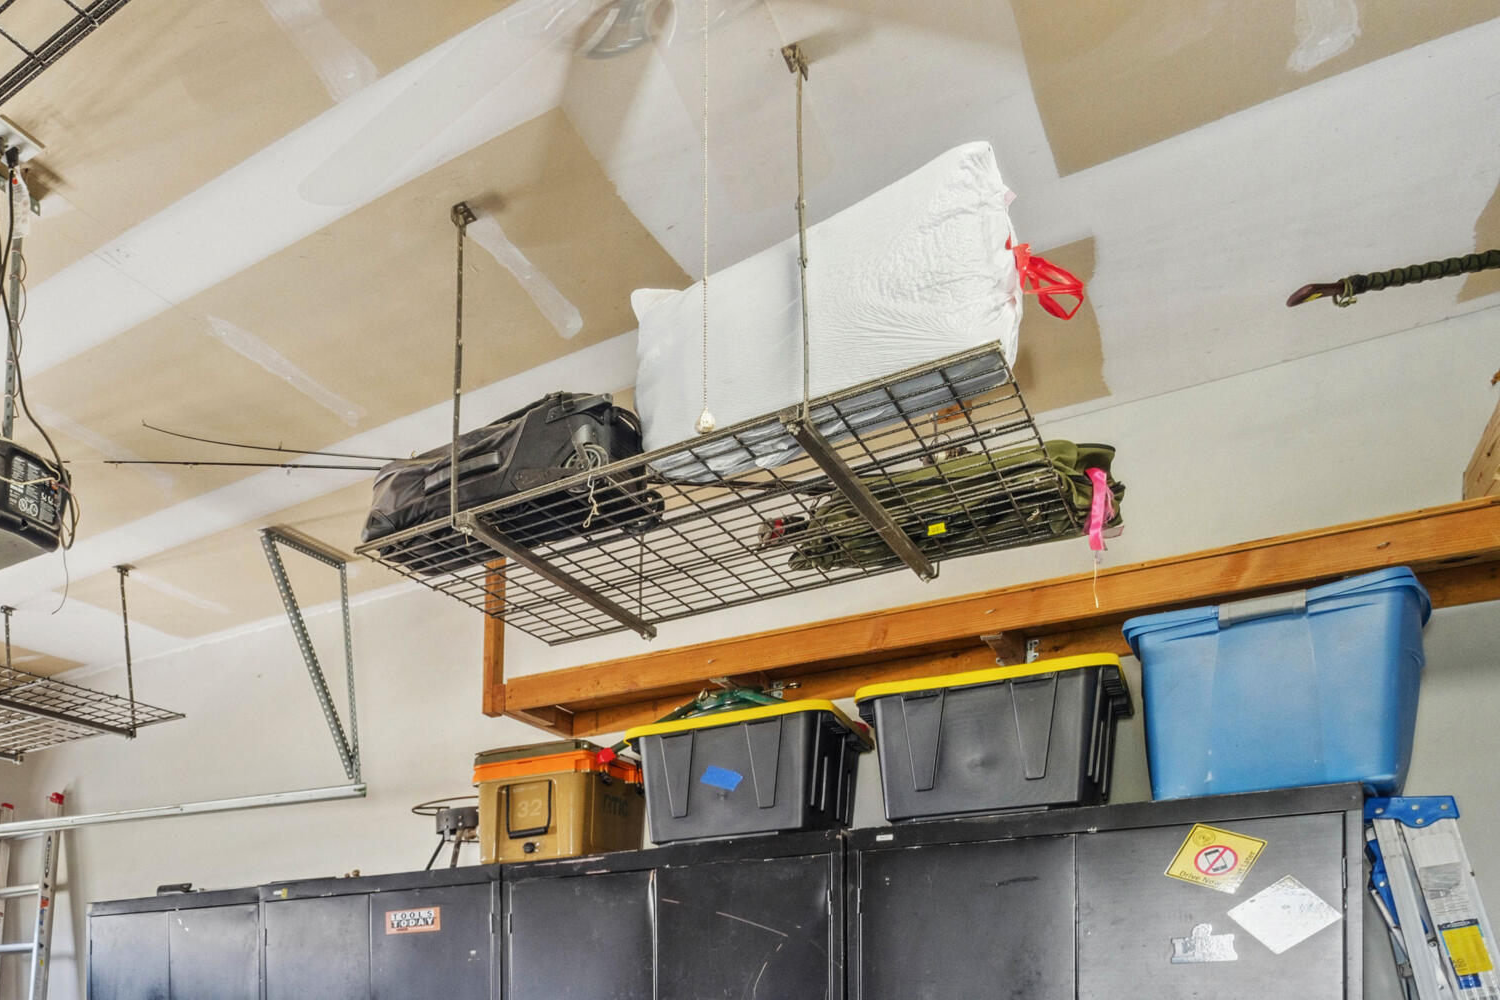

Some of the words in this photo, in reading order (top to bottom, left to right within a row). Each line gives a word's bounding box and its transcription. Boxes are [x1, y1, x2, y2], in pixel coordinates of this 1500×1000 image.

[518, 798, 542, 818] 32
[391, 910, 434, 920] TOOLS
[391, 918, 434, 928] TODAY
